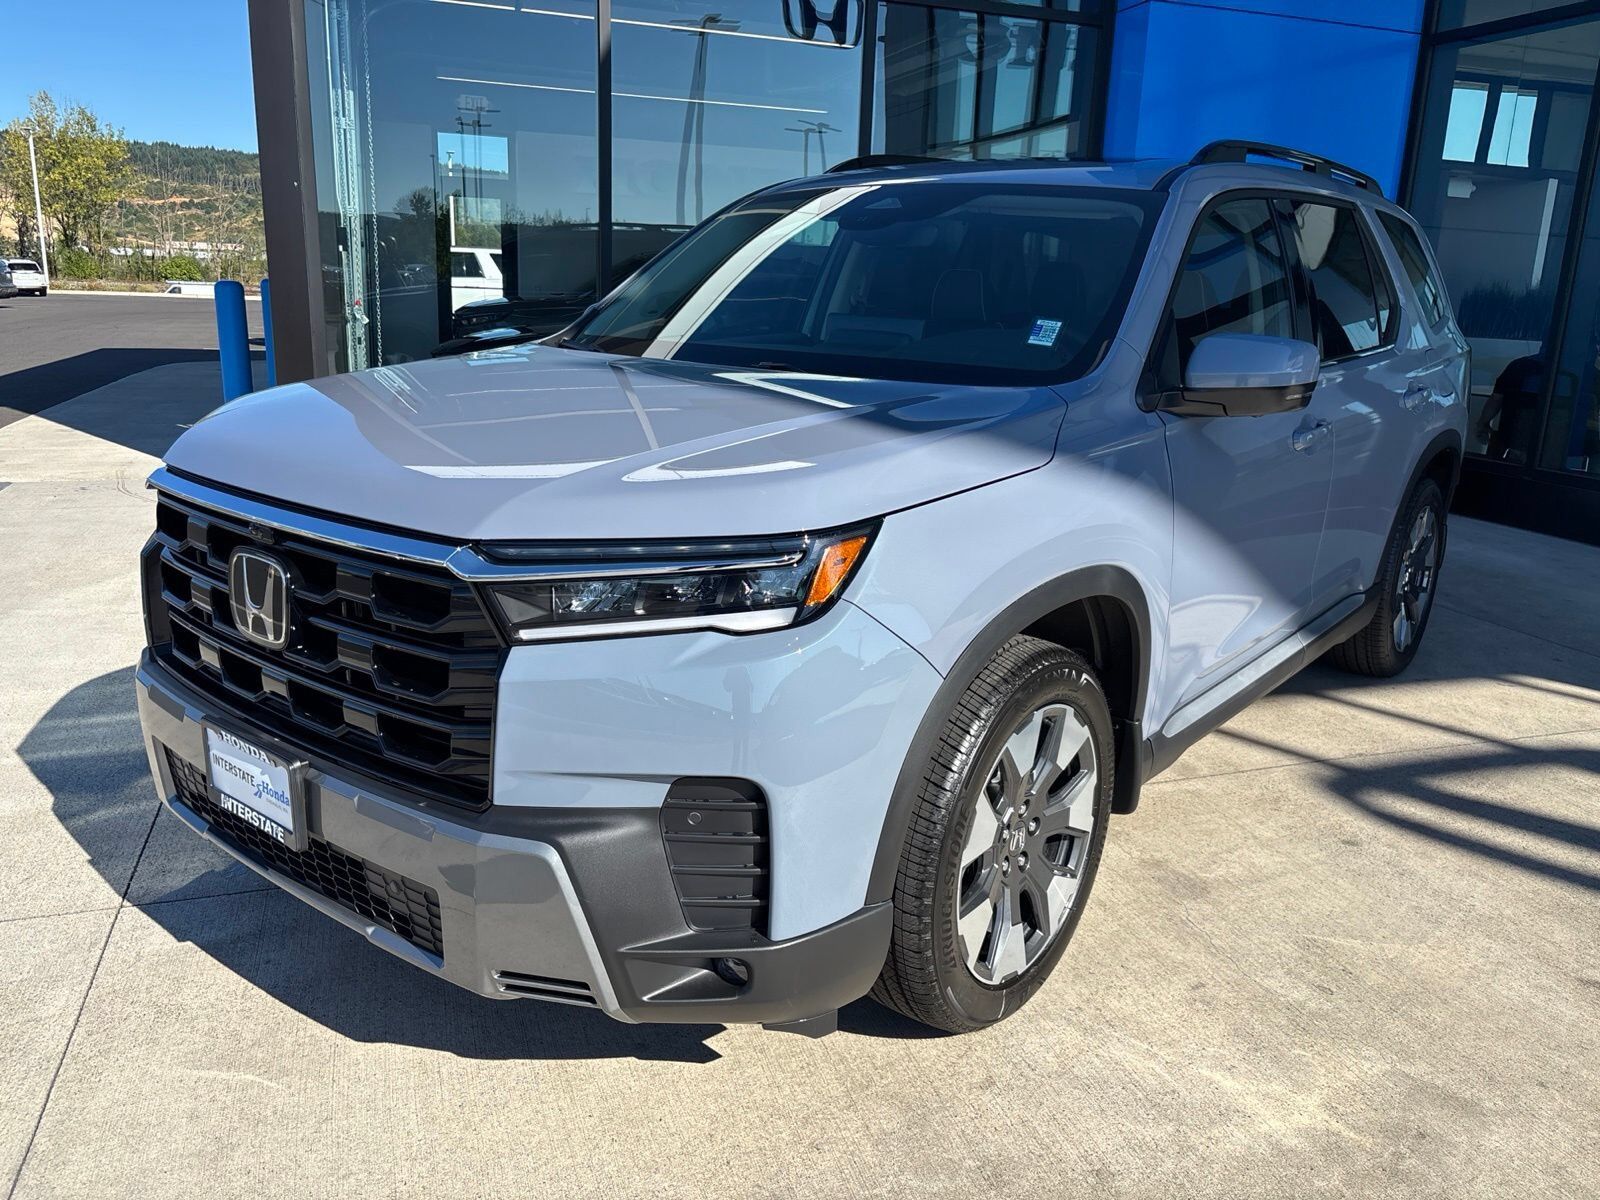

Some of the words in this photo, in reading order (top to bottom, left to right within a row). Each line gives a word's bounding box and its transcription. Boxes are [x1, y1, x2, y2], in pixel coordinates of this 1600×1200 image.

[221, 731, 269, 763] HONDA
[212, 753, 255, 786] INTERSTATE
[261, 780, 289, 806] Honda
[221, 793, 284, 843] INTERSTATE
